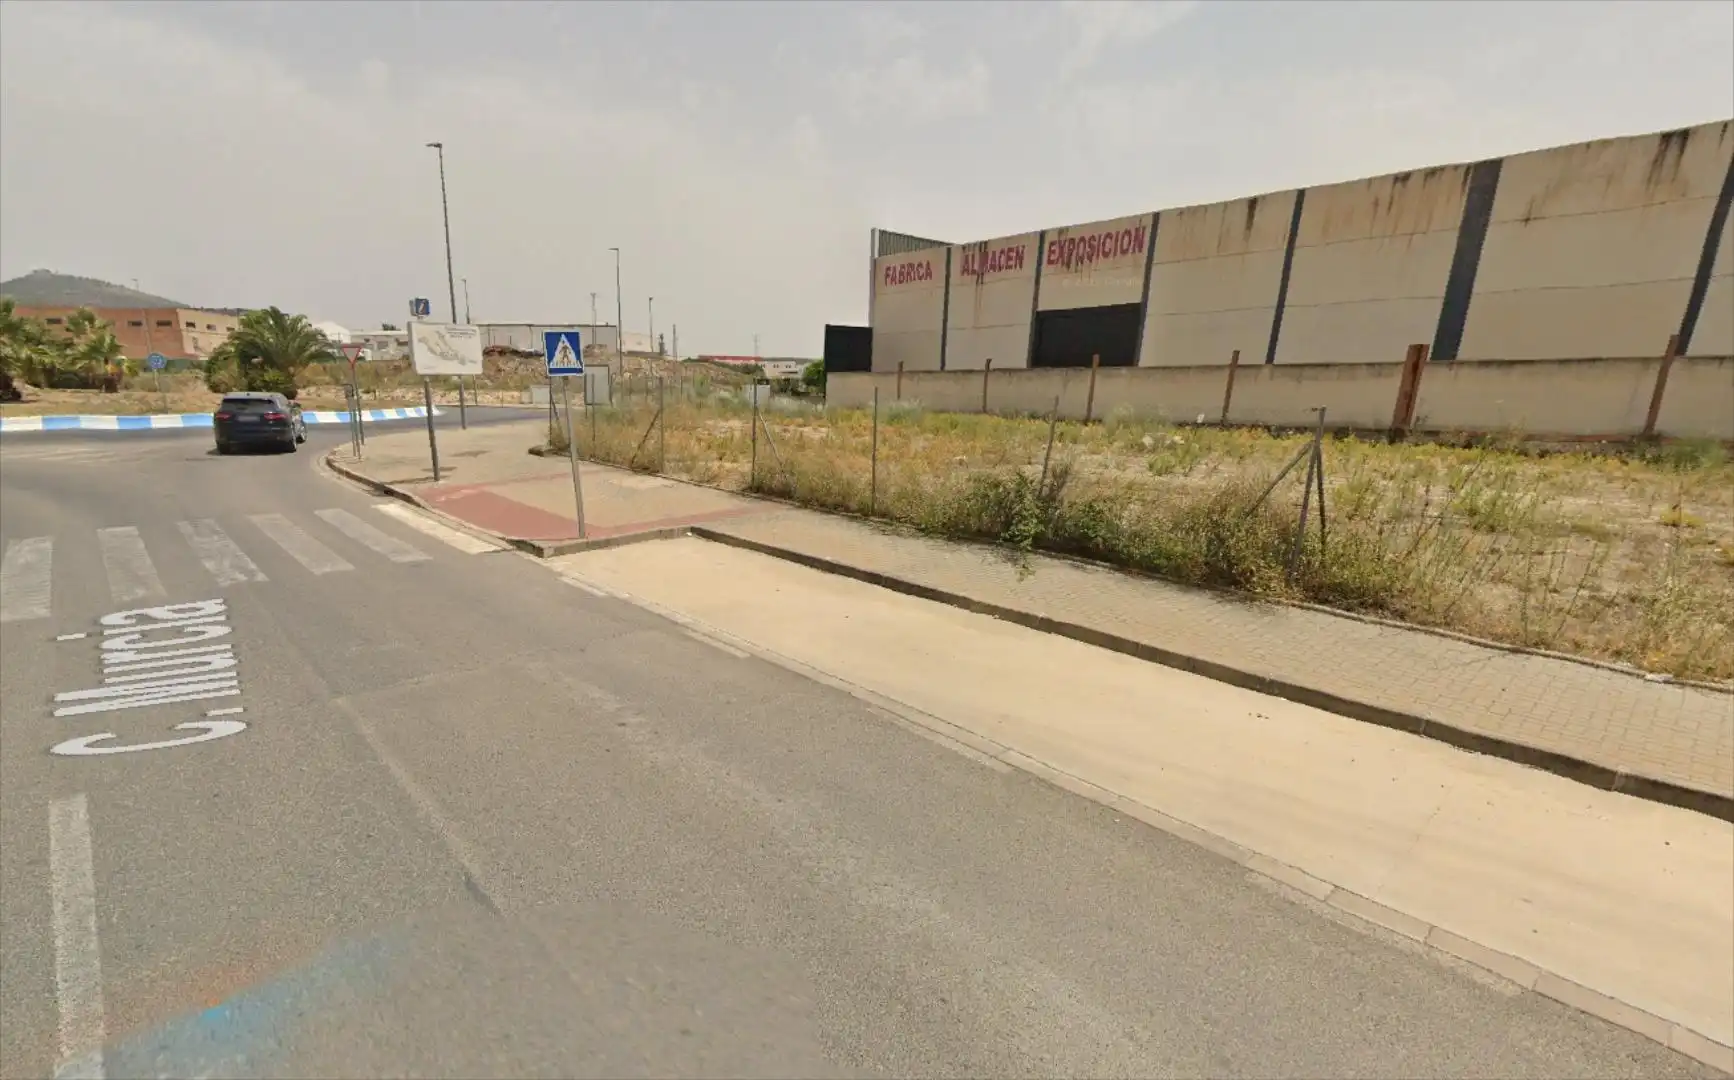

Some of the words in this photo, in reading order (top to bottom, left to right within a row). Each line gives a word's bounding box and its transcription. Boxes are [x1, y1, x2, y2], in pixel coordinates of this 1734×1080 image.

[884, 261, 933, 286] FABRICA
[960, 245, 1026, 278] ALMACEN
[1047, 227, 1147, 268] EXPOSICION
